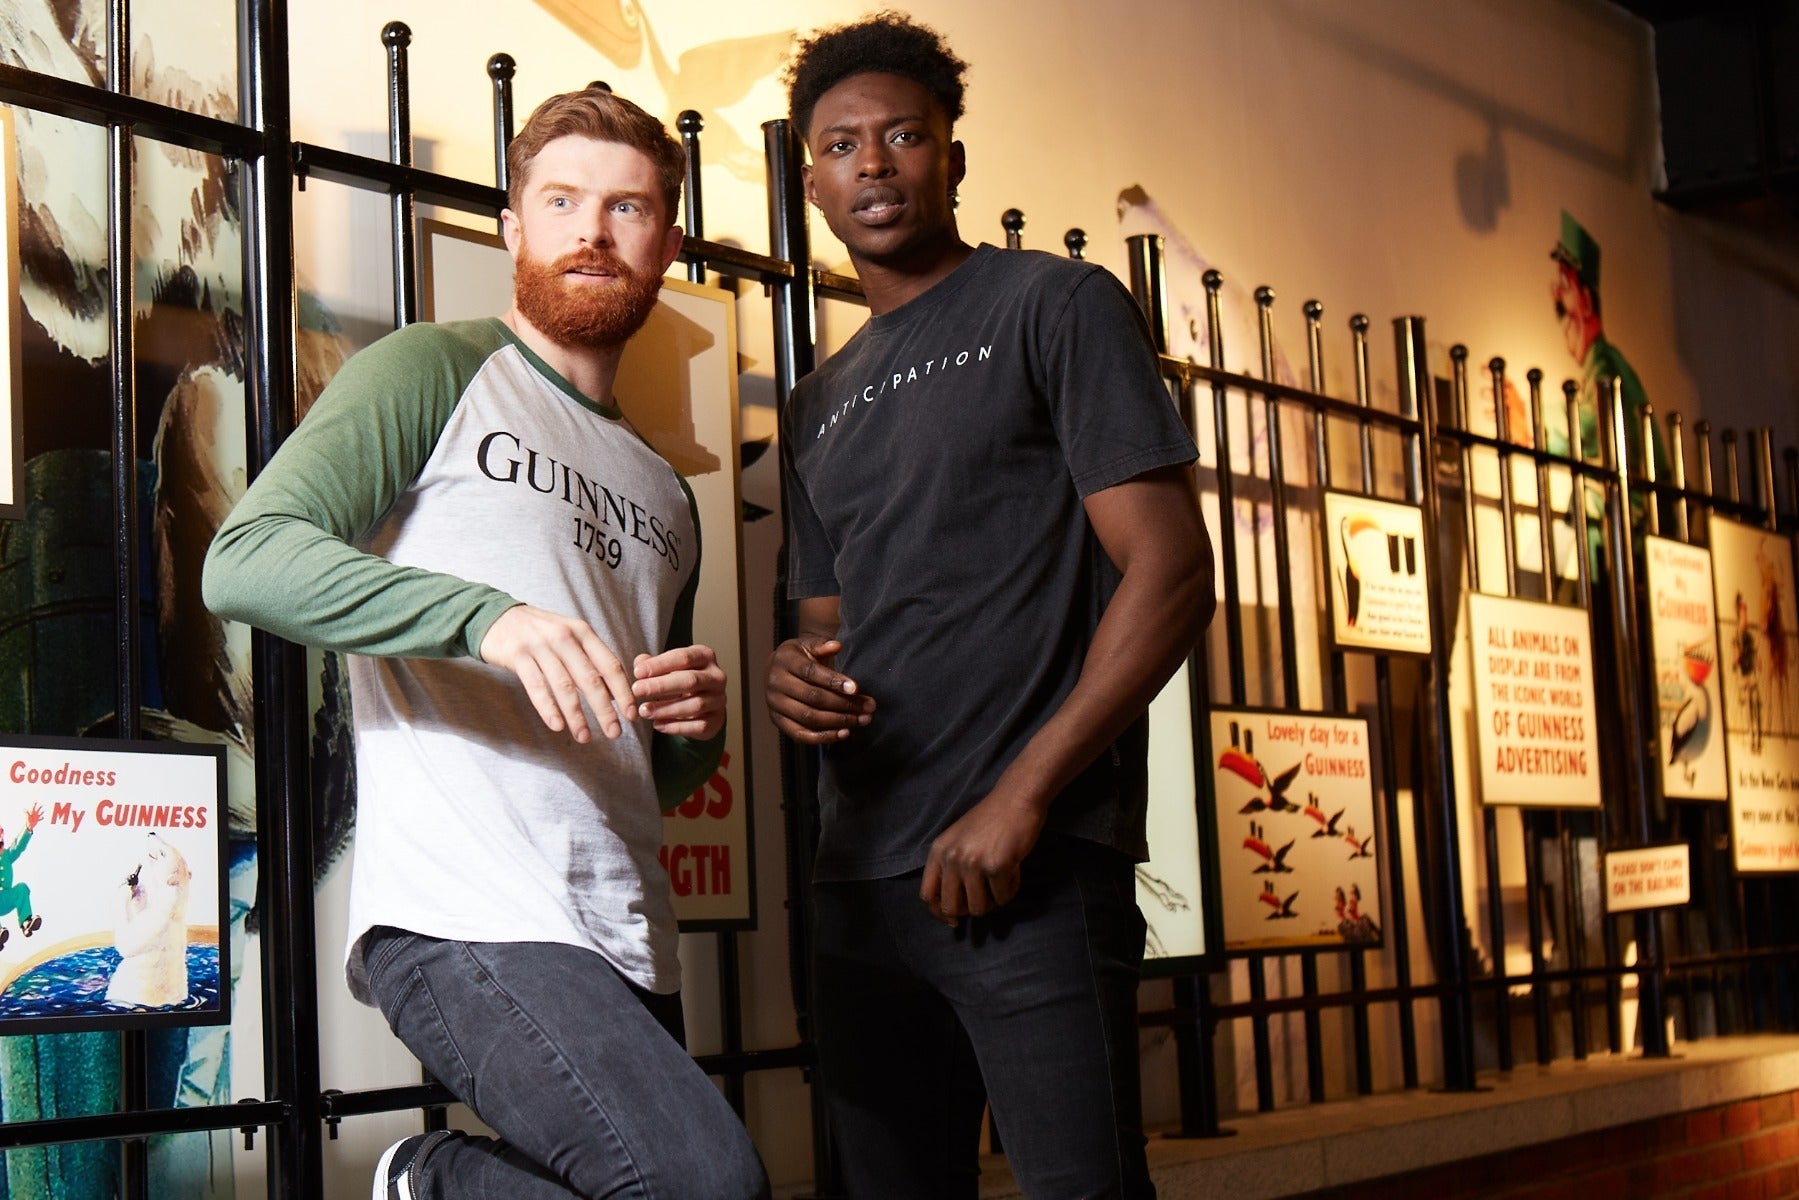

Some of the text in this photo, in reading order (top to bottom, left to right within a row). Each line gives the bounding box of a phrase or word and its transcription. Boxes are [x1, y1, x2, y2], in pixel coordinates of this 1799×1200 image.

[817, 345, 992, 439] ANTICIPATION
[477, 431, 680, 572] GUINNESS
[573, 517, 622, 569] 1759
[1488, 626, 1579, 657] ALL ANIMALS ON
[1488, 655, 1581, 683] DISPLAY ARE FROM
[1491, 682, 1582, 709] THE ICONIC WORLD
[1267, 720, 1359, 747] Lovely day for a
[1493, 710, 1585, 742] OF GUINNESS
[9, 760, 117, 787] Goodness
[1305, 753, 1365, 778] GUINNESS
[1496, 745, 1587, 777] ADVERTISING
[51, 799, 208, 833] My GUINNESS
